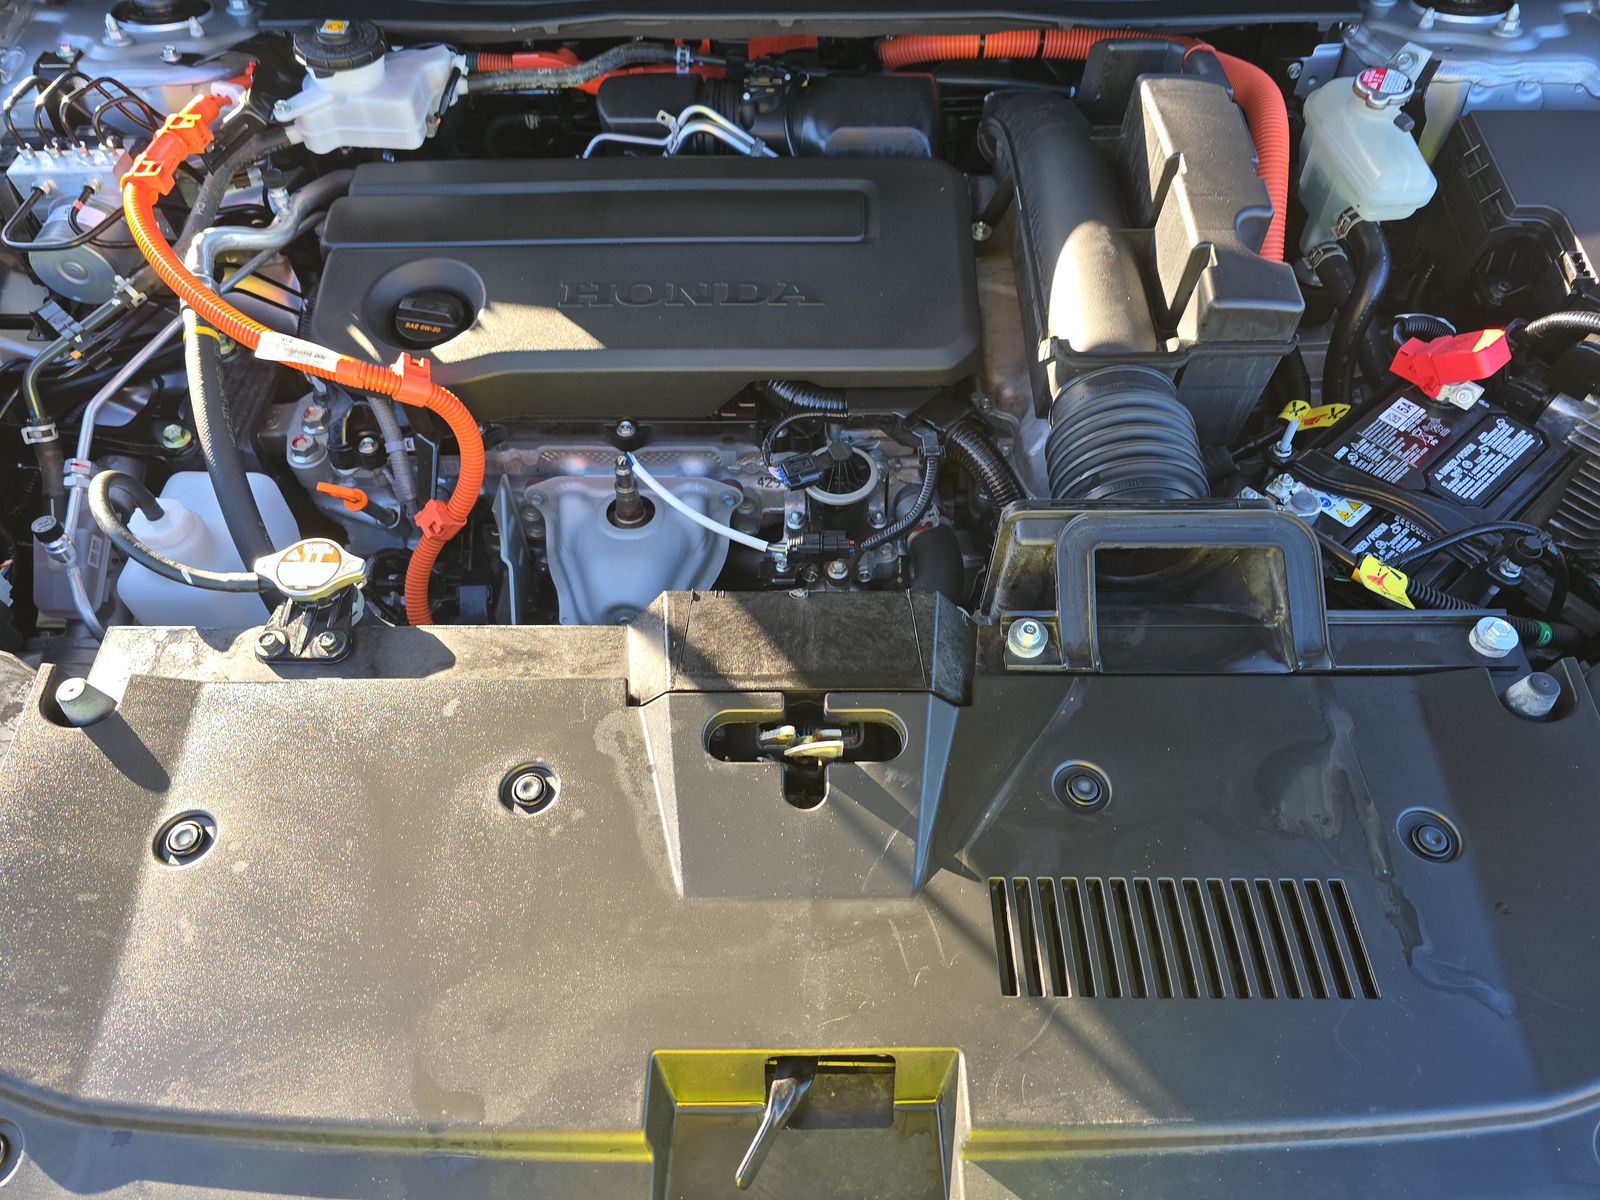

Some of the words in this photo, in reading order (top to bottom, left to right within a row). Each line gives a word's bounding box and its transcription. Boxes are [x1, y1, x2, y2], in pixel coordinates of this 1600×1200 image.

[558, 280, 826, 308] HONDA
[404, 322, 419, 330] SAE
[420, 324, 442, 333] 0W-20
[1396, 401, 1416, 414] 5A
